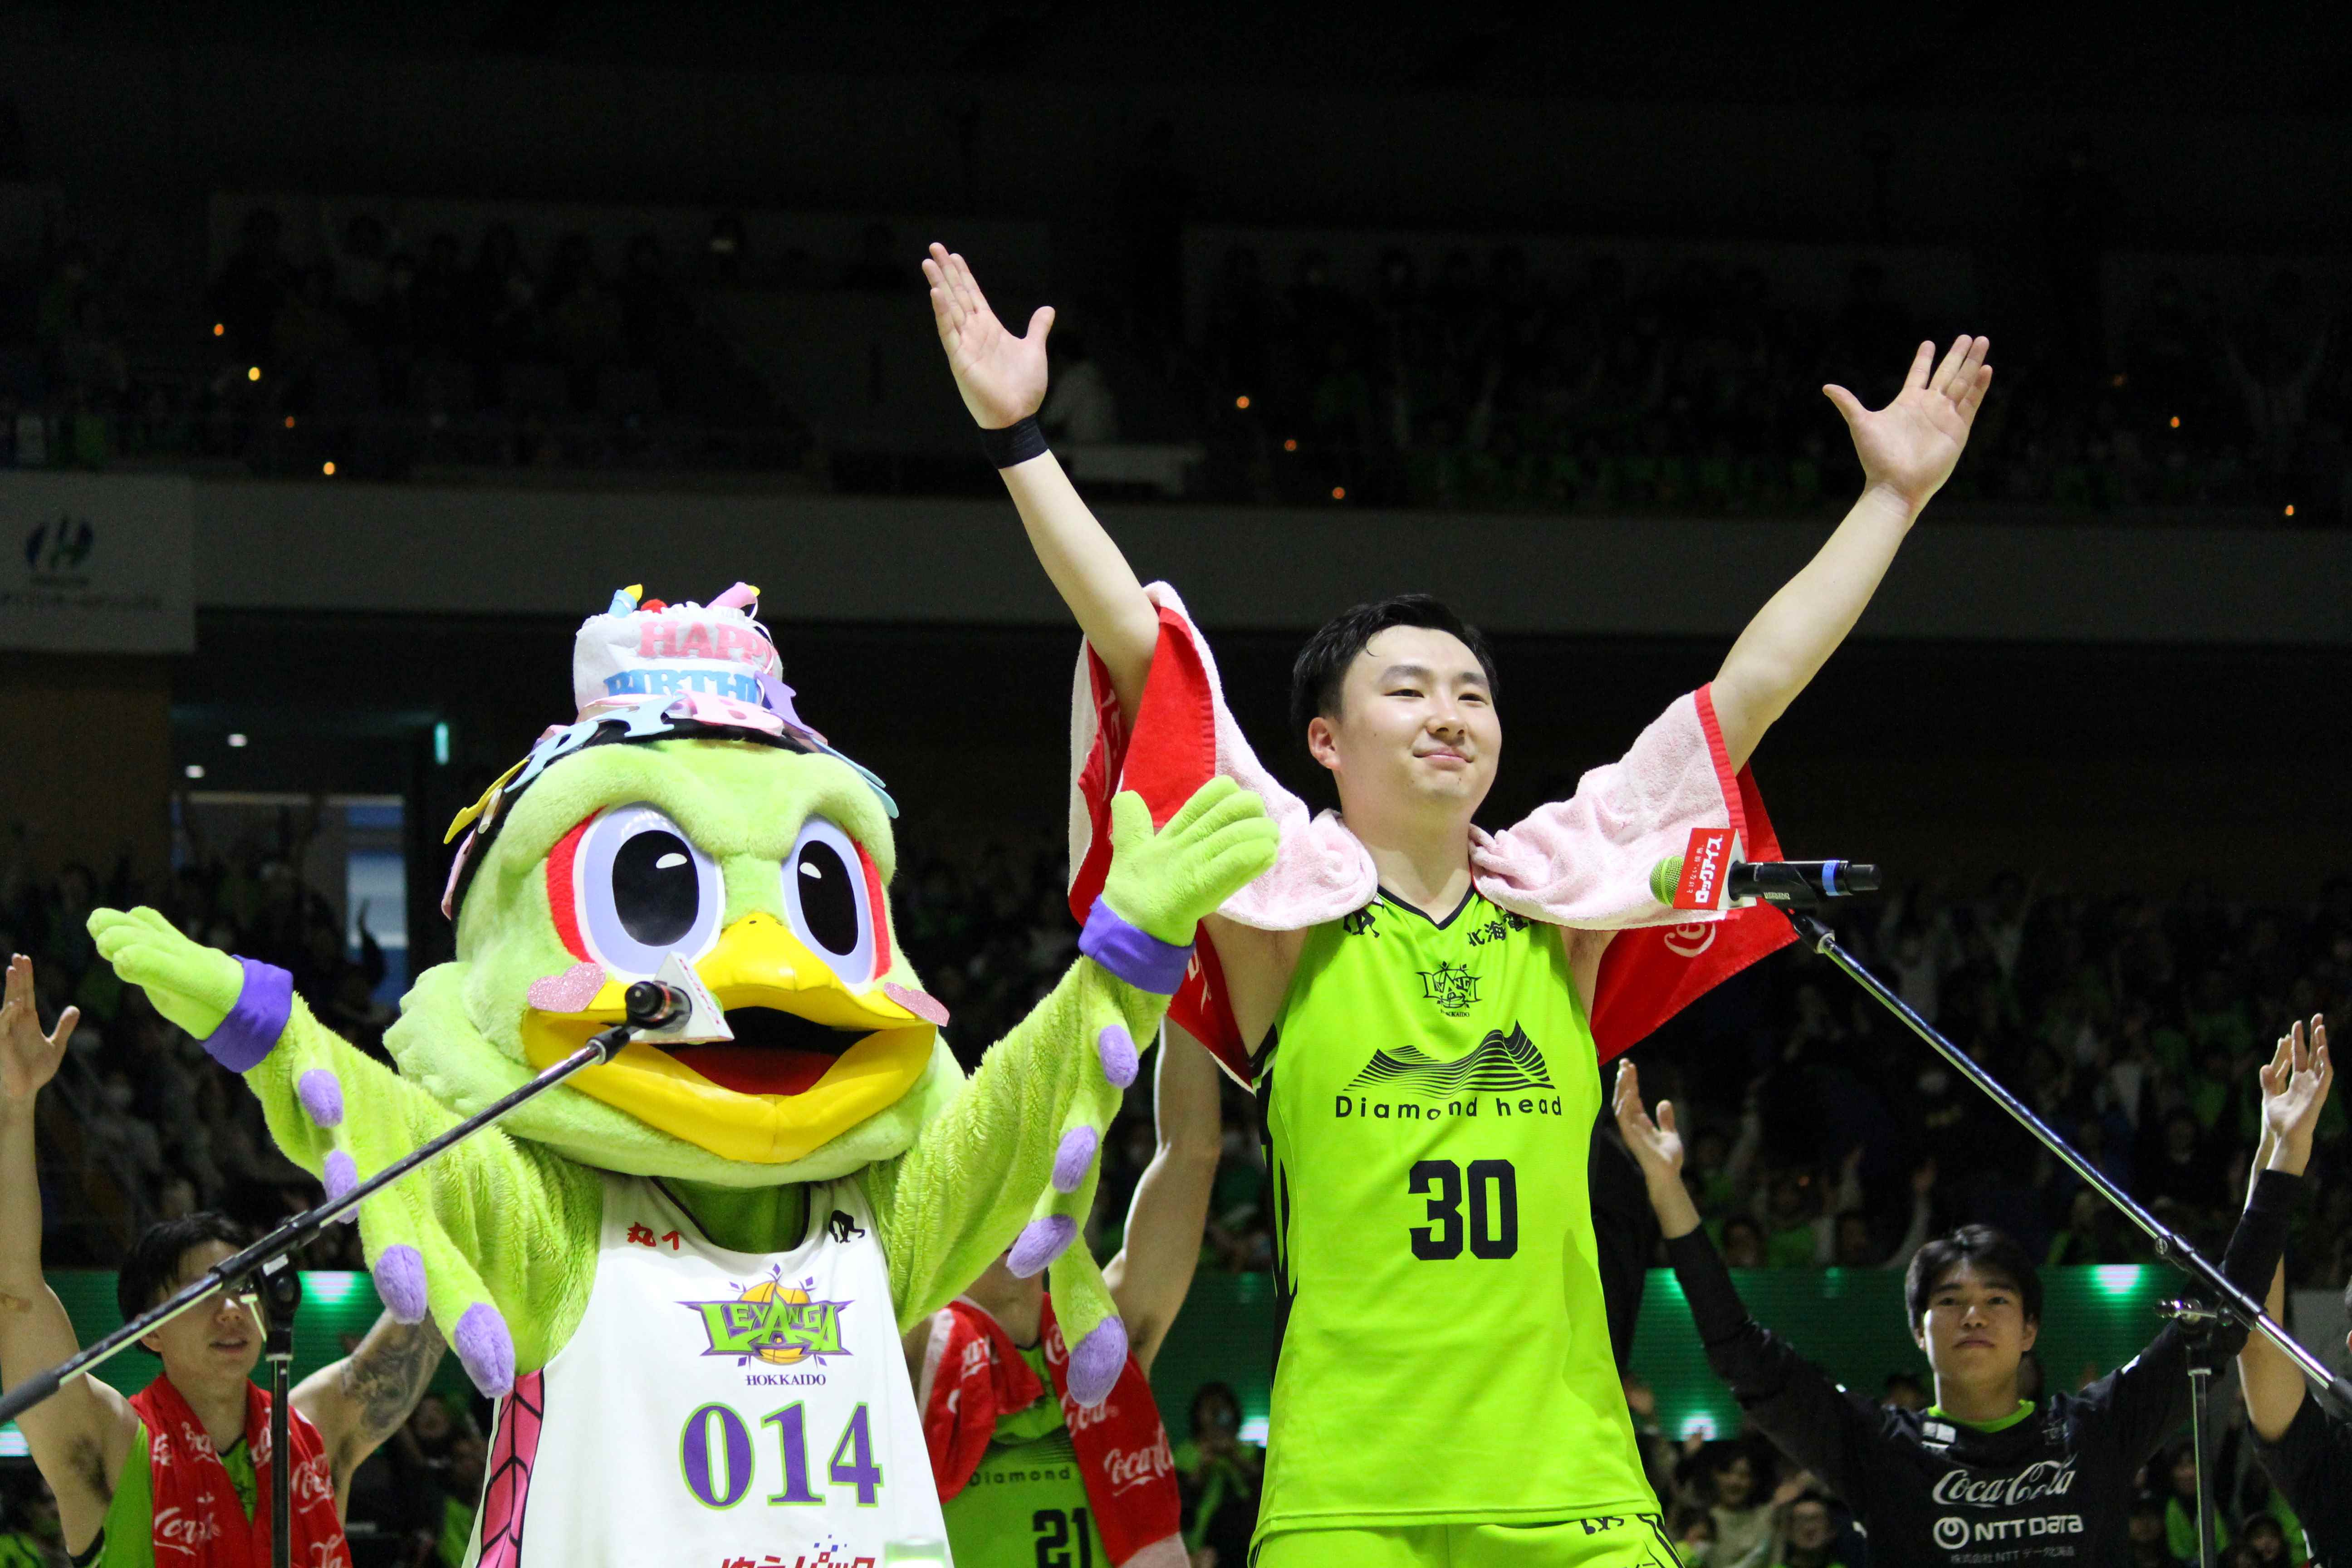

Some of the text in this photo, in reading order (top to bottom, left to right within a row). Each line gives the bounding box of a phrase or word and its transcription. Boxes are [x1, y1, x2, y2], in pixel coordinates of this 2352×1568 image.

[637, 621, 773, 667] HAPP
[1695, 837, 1723, 903] ロックアイス
[1336, 1096, 1562, 1120] Diamond head
[1408, 1159, 1518, 1260] 30
[745, 1373, 826, 1386] HOKKAIDO
[681, 1401, 884, 1509] 014
[1932, 1452, 2079, 1508] Coca-Cola
[1033, 1507, 1092, 1568] 21
[1975, 1519, 2026, 1542] NTT
